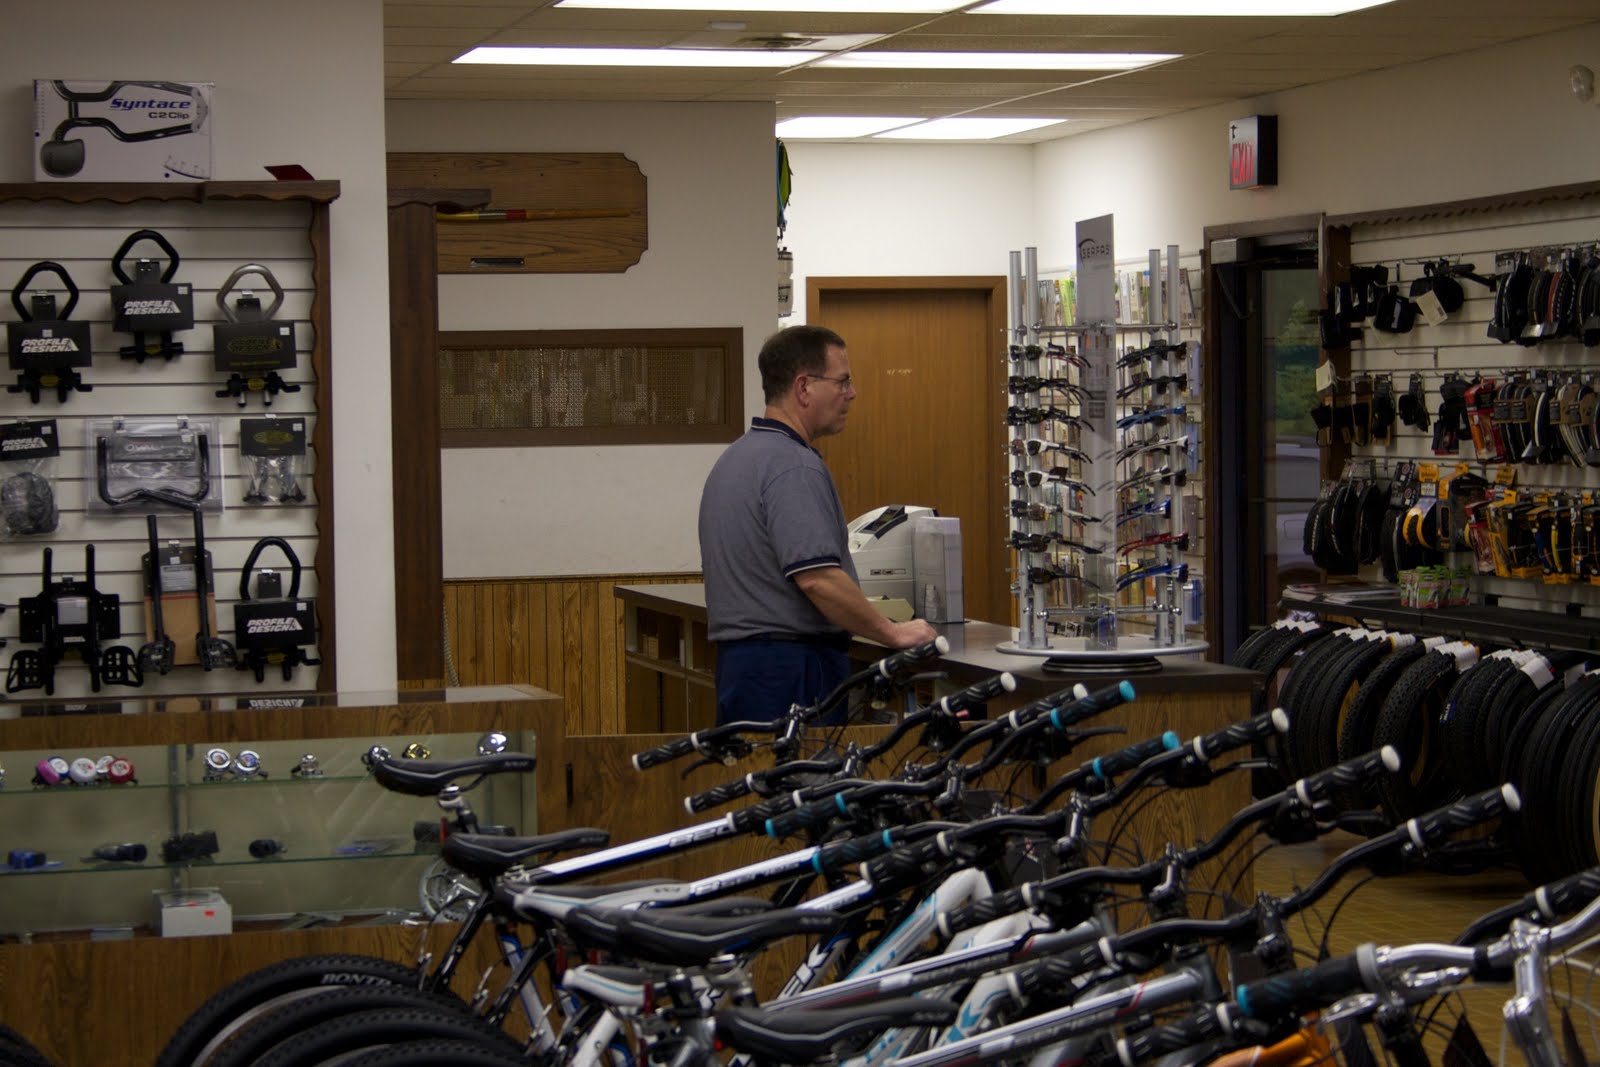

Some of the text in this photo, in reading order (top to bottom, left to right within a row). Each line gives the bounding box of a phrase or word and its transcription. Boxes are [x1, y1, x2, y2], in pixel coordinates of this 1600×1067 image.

[110, 98, 191, 111] Syntace
[148, 111, 190, 120] C2 Clip
[123, 299, 172, 309] PROFILE
[124, 306, 168, 316] DESIGN
[21, 337, 69, 347] PROFILE
[21, 345, 65, 354] DESIGN
[246, 617, 293, 627] PROFILE
[247, 624, 289, 634] DESIGN
